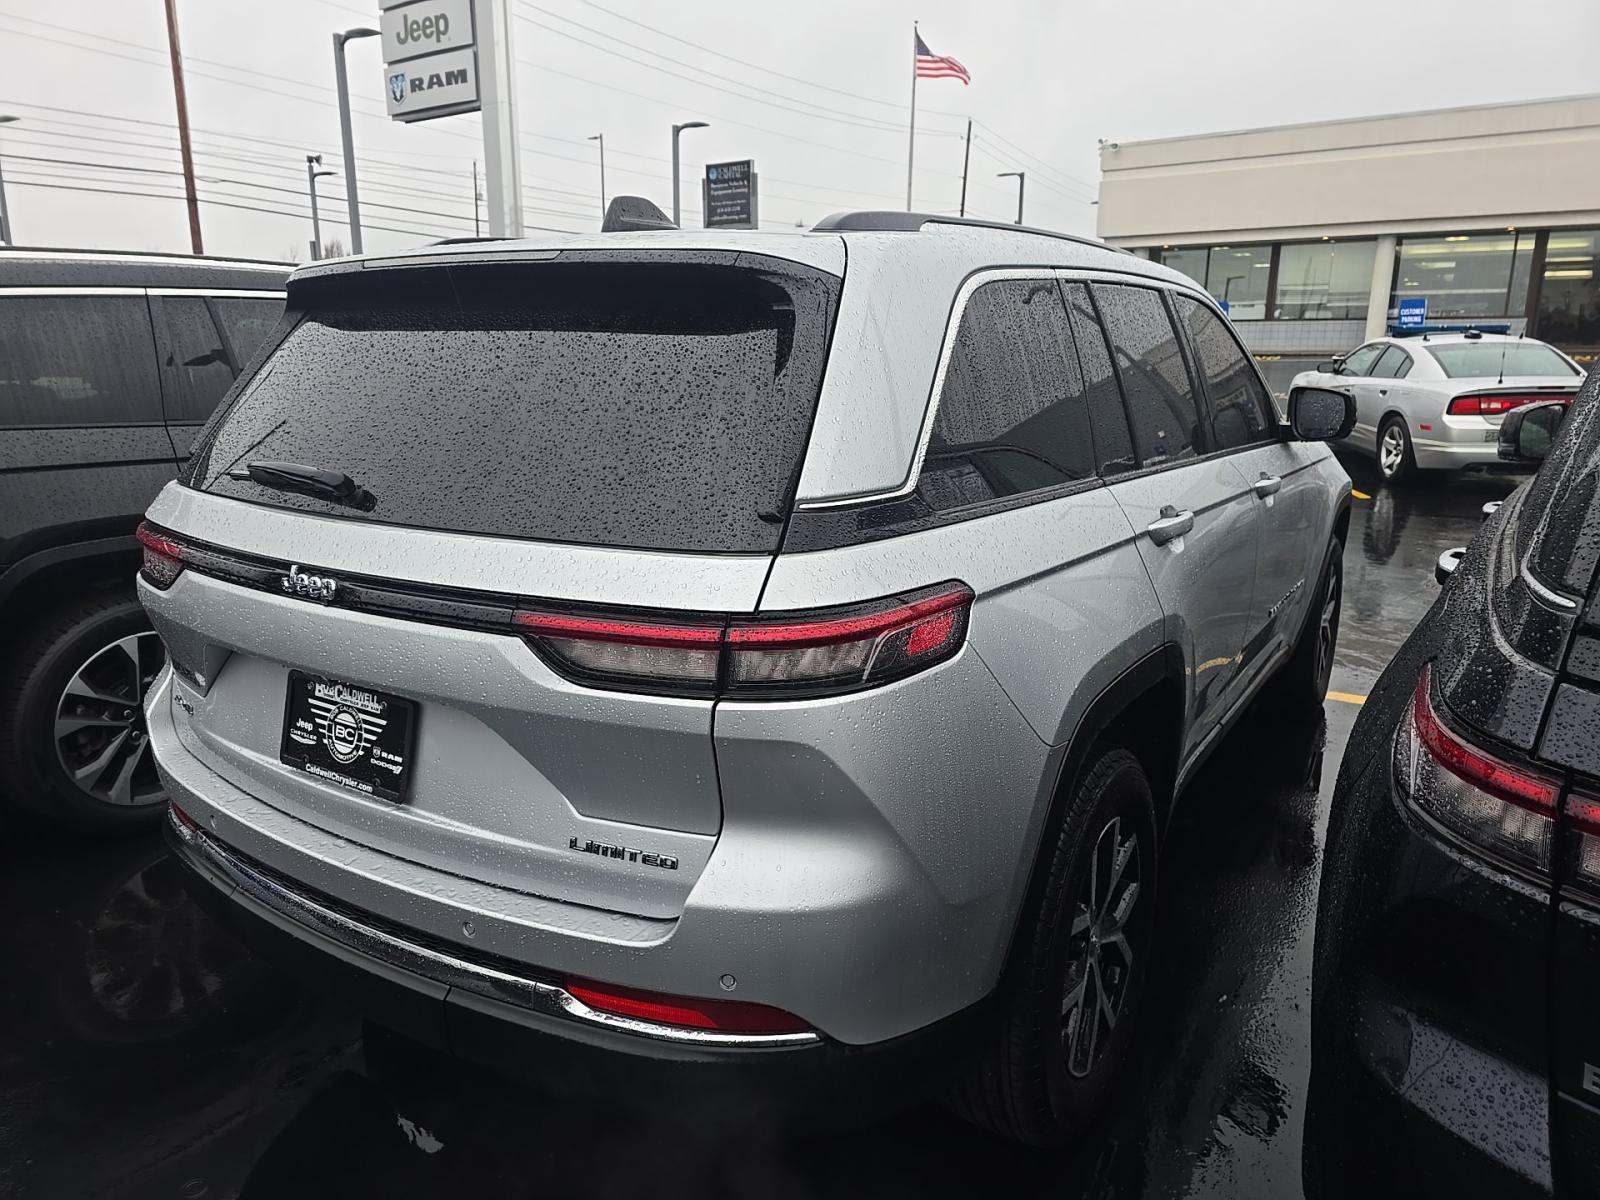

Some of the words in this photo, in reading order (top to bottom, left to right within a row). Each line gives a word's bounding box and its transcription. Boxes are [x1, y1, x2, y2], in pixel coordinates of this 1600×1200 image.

[396, 13, 449, 45] Jeep
[409, 69, 468, 94] RAM
[281, 564, 337, 602] Jeep
[334, 684, 379, 707] CALDWELL
[296, 718, 314, 732] Jeep
[335, 724, 355, 740] BC
[305, 763, 373, 793] CaldwellChrysler.com
[568, 835, 679, 871] LIMITED
